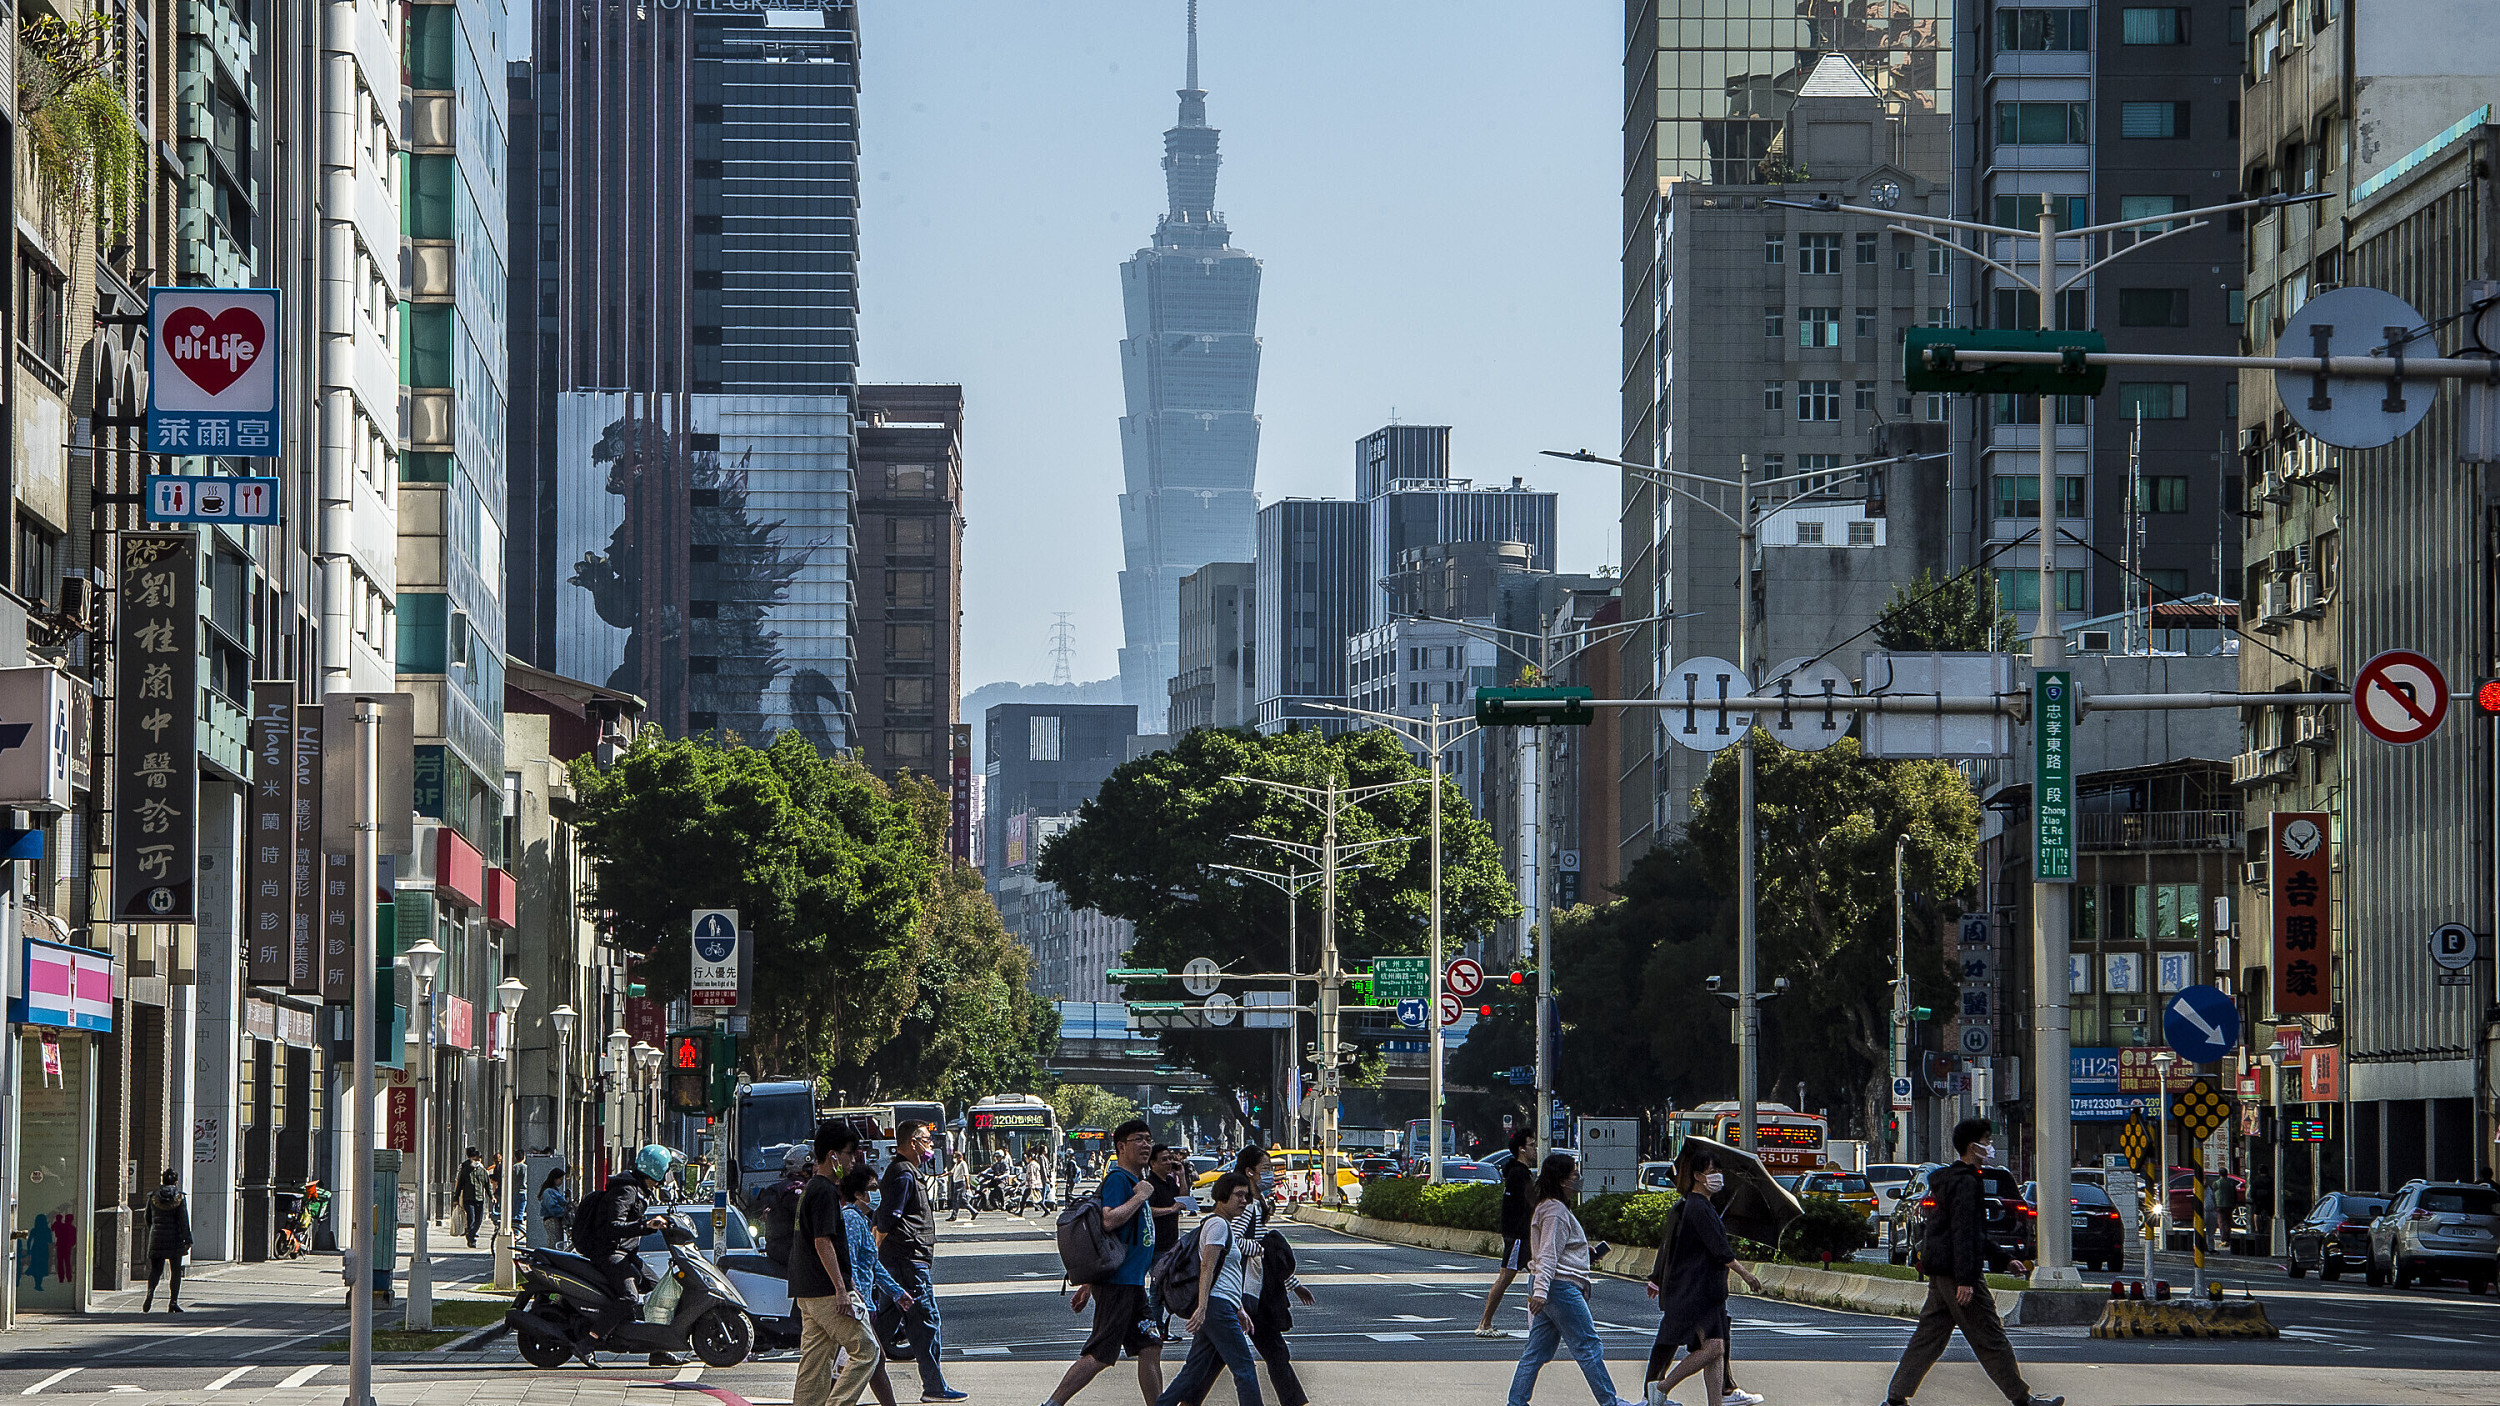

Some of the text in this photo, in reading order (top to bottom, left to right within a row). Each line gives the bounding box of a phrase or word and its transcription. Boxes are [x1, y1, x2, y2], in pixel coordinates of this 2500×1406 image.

[174, 325, 255, 373] Hi-Life
[158, 418, 270, 447] 萊爾富
[133, 571, 181, 880] 劉桂蘭中醫診所
[255, 703, 289, 765] Milano
[298, 726, 319, 785] Milano
[2046, 704, 2062, 803] 忠孝東路一段
[2041, 805, 2066, 817] Zhong
[2042, 816, 2060, 825] Xiao
[259, 780, 281, 964] 米蘭時尚診所
[693, 966, 736, 979] 行人優先
[2081, 1057, 2118, 1078] H25
[394, 1090, 408, 1150] 台中銀行
